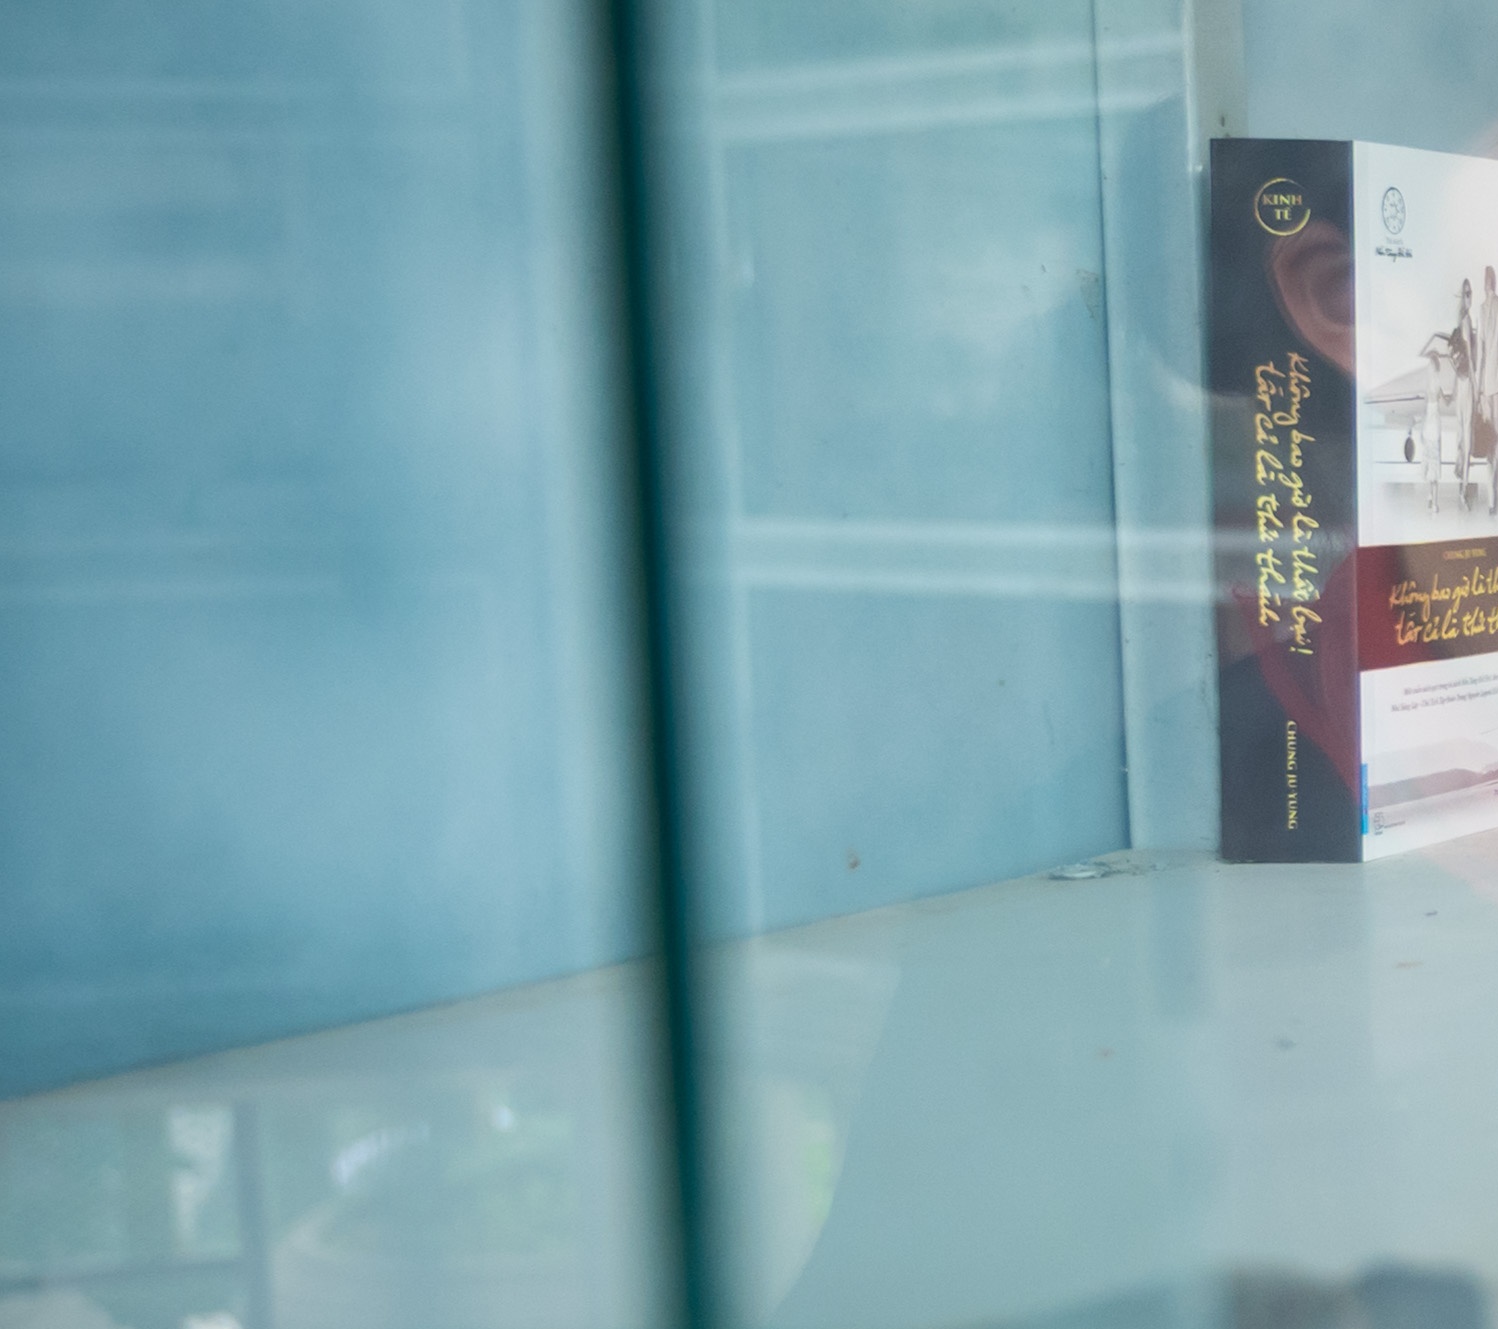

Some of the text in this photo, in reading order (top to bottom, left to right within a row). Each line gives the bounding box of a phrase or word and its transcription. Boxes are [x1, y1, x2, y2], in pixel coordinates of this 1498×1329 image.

[1262, 194, 1303, 205] KINH
[1274, 352, 1312, 426] Không
[1255, 449, 1283, 486] là
[1290, 429, 1316, 468] bao
[1292, 512, 1320, 544] là
[1286, 720, 1298, 770] CHUNG
